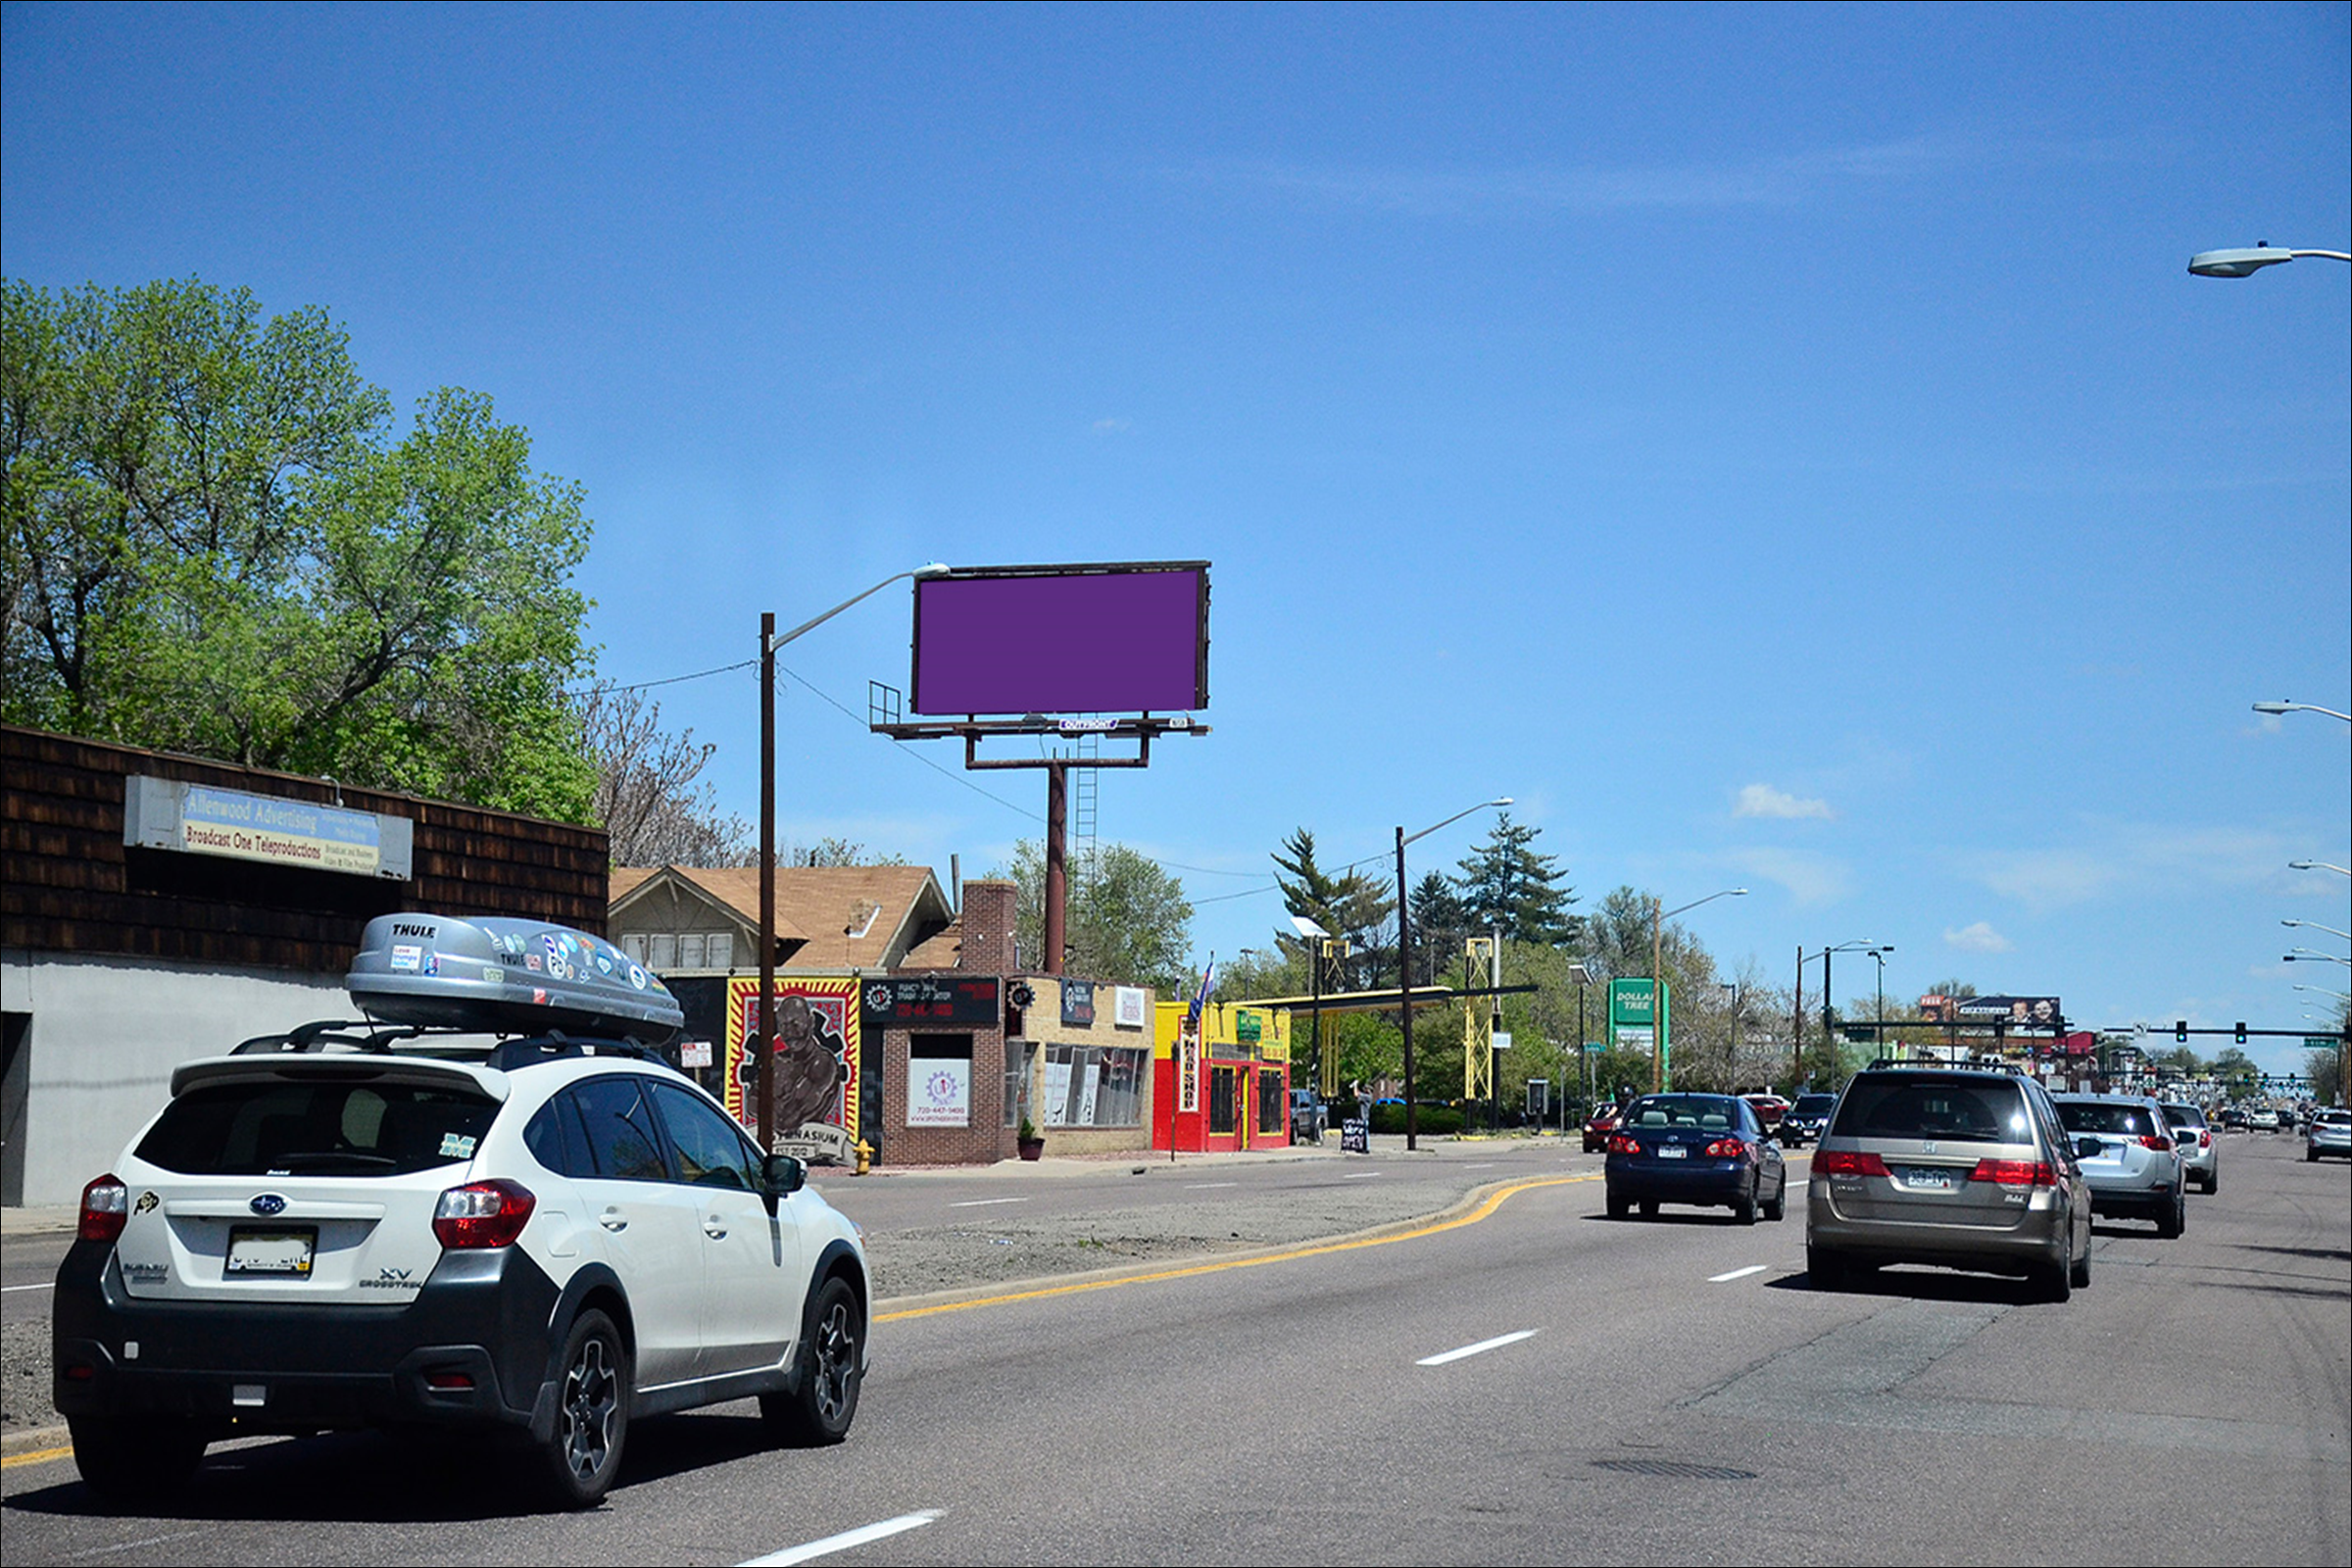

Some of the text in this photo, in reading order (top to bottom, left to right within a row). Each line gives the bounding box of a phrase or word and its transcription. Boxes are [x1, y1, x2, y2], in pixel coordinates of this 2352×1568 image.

[187, 793, 252, 820] Allenwood
[256, 804, 318, 835] Advertising
[186, 825, 321, 859] Broadcast One Teleproductions
[393, 923, 437, 938] THULE
[501, 953, 526, 966] THULE
[1623, 1001, 1650, 1010] TREE
[1184, 1073, 1195, 1108] SHOP
[379, 1267, 414, 1280] XV
